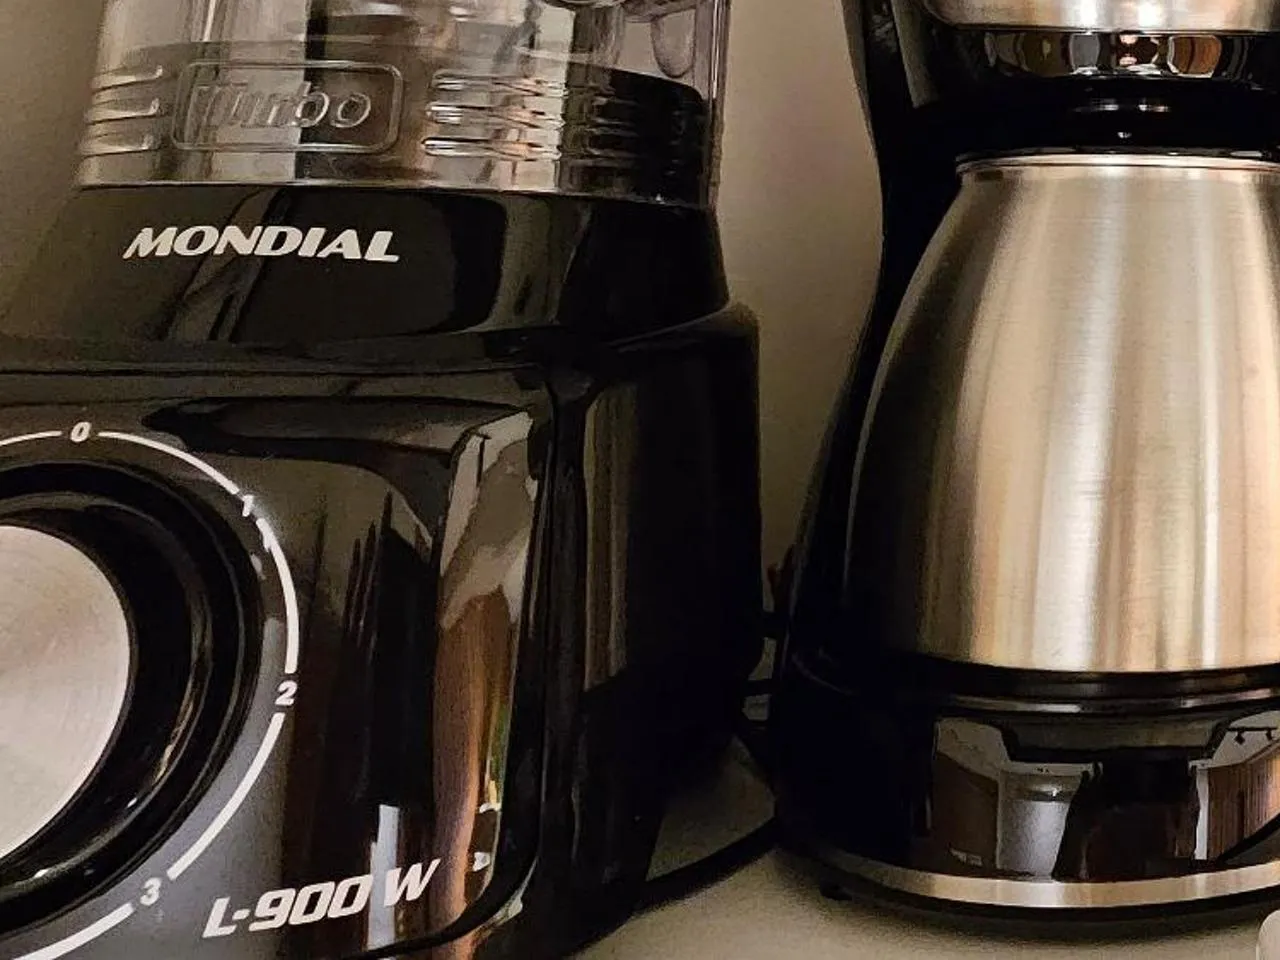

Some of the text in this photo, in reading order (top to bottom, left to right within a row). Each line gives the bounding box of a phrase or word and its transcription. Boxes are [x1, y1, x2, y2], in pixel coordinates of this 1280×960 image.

[122, 225, 400, 263] MONDIAL
[70, 421, 92, 442] 0
[240, 494, 256, 518] 1
[275, 681, 298, 707] 2
[140, 878, 163, 907] 3
[202, 857, 442, 939] L-900 W
